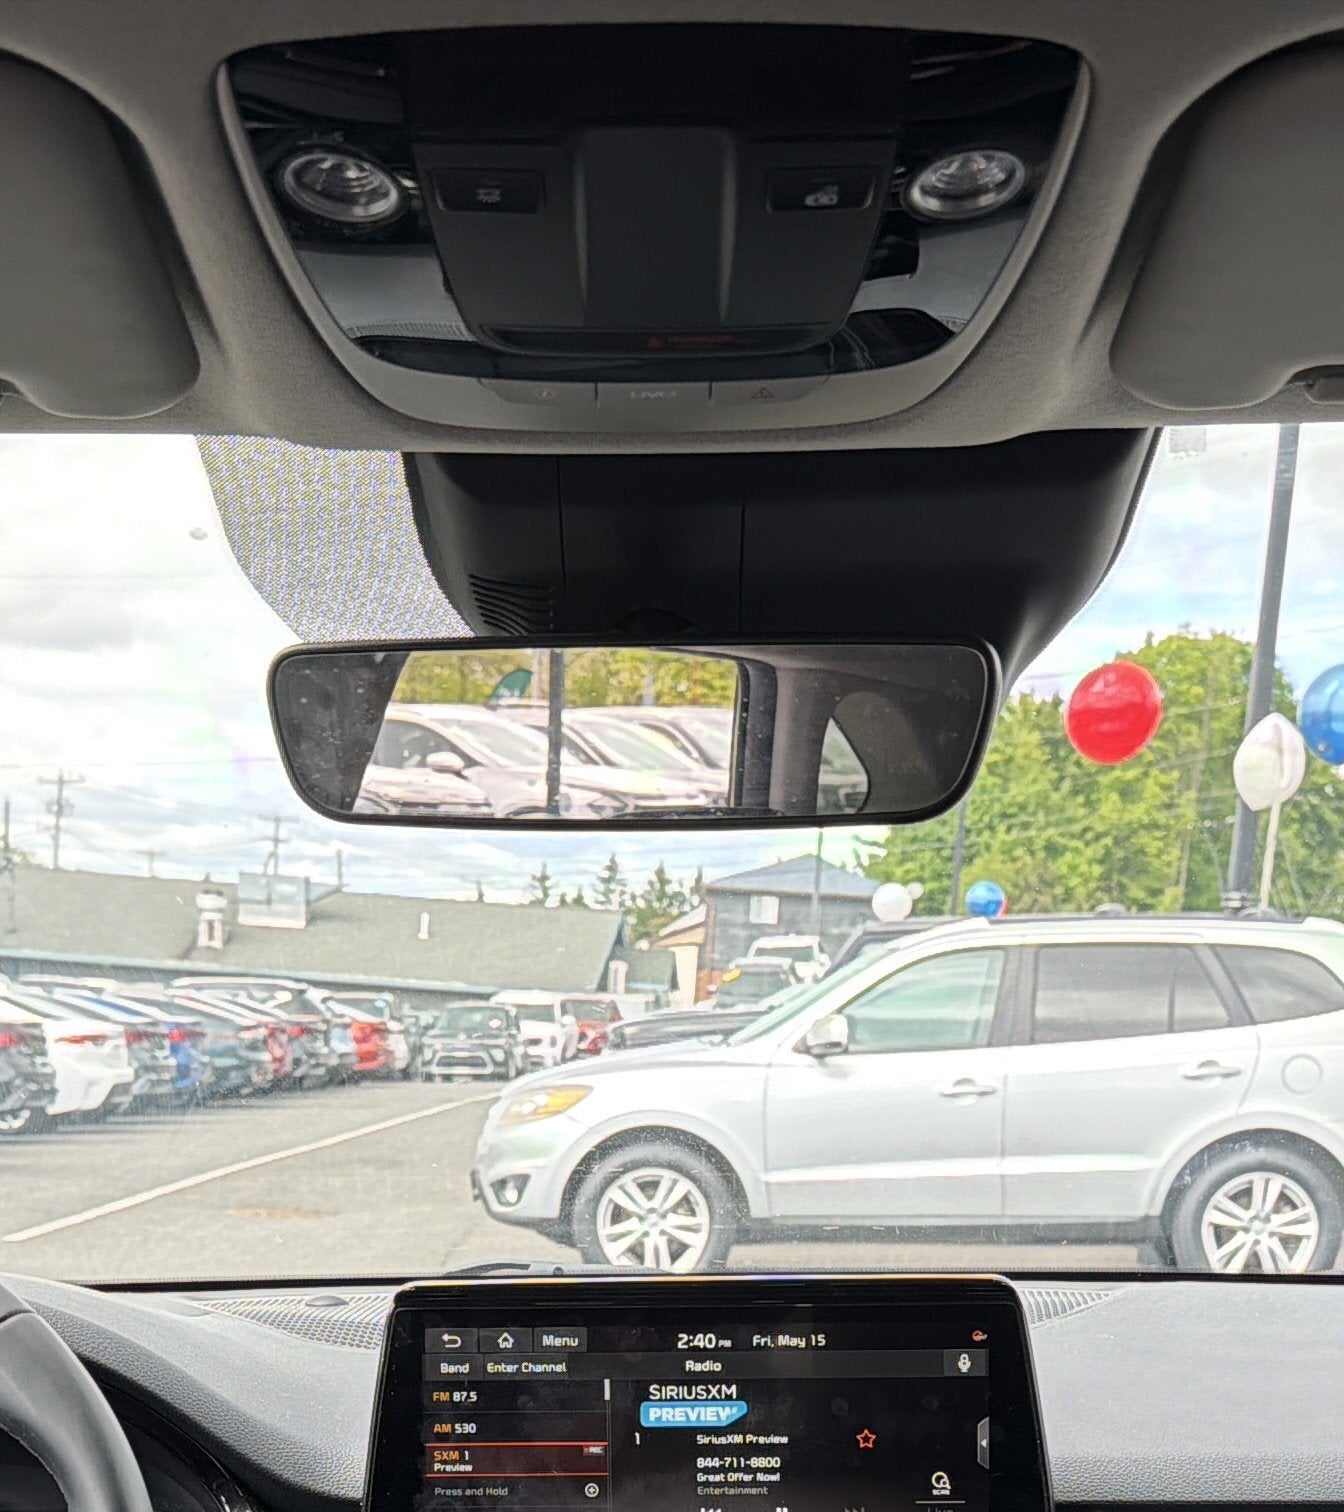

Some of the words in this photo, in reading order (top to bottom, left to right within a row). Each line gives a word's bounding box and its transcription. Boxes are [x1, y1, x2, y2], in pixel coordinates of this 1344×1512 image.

[542, 1334, 579, 1347] Menu
[677, 1333, 716, 1349] 2:40
[717, 1339, 732, 1348] PM
[777, 1334, 806, 1348] May
[810, 1334, 826, 1346] 15
[440, 1362, 470, 1373] Band
[486, 1362, 519, 1373] Enter
[521, 1361, 567, 1373] Channel
[685, 1360, 722, 1372] Radio
[432, 1392, 450, 1401] FM
[452, 1391, 478, 1402] 87.5
[648, 1384, 737, 1400] SIRIUSXM
[648, 1407, 739, 1422] PREVIEW
[433, 1423, 452, 1433] AM
[454, 1423, 477, 1433] 530
[634, 1432, 641, 1445] 1
[696, 1434, 744, 1444] SiriusXM
[745, 1434, 789, 1444] Preview
[433, 1451, 460, 1461] SXM
[464, 1450, 469, 1461] 1
[433, 1463, 473, 1472] Preview
[696, 1457, 781, 1468] 844-711-8800
[696, 1473, 725, 1482] Great
[727, 1473, 754, 1482] Offer
[756, 1473, 781, 1482] Now!
[434, 1487, 463, 1496] Press
[465, 1487, 484, 1496] and
[486, 1487, 509, 1496] Hold
[697, 1486, 769, 1495] Entertainment
